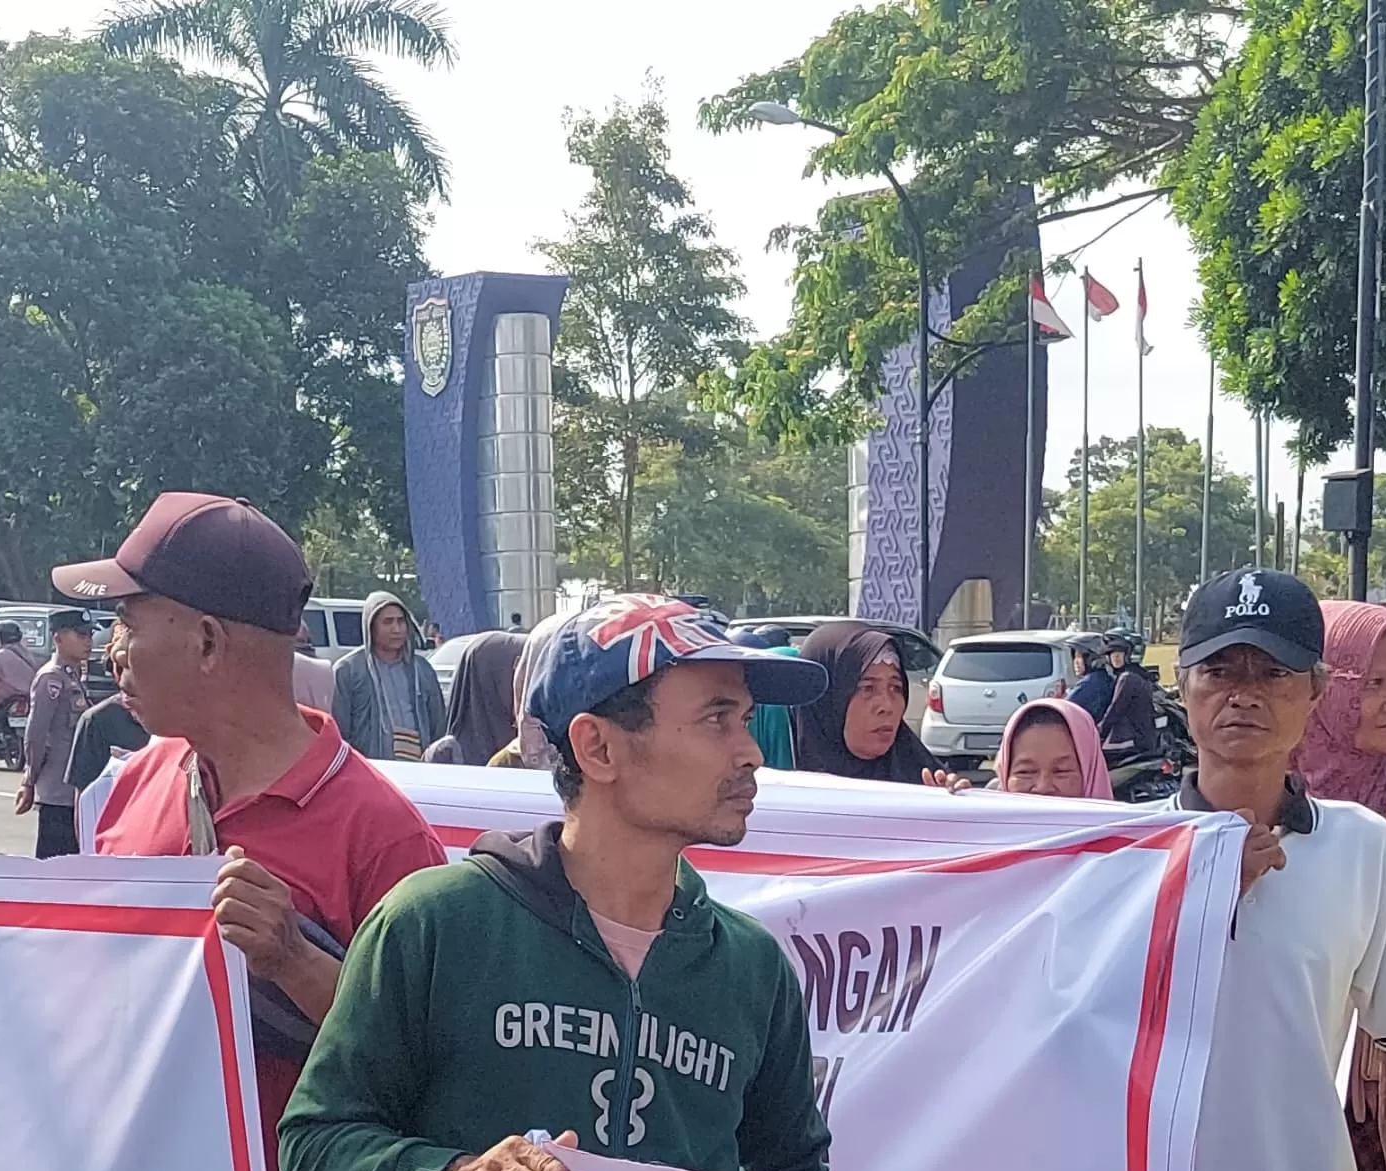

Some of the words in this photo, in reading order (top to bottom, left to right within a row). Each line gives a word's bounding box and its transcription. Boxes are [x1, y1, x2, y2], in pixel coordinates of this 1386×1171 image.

[73, 579, 108, 596] NIKE
[1224, 603, 1270, 619] POLO
[789, 925, 942, 1034] NGAN
